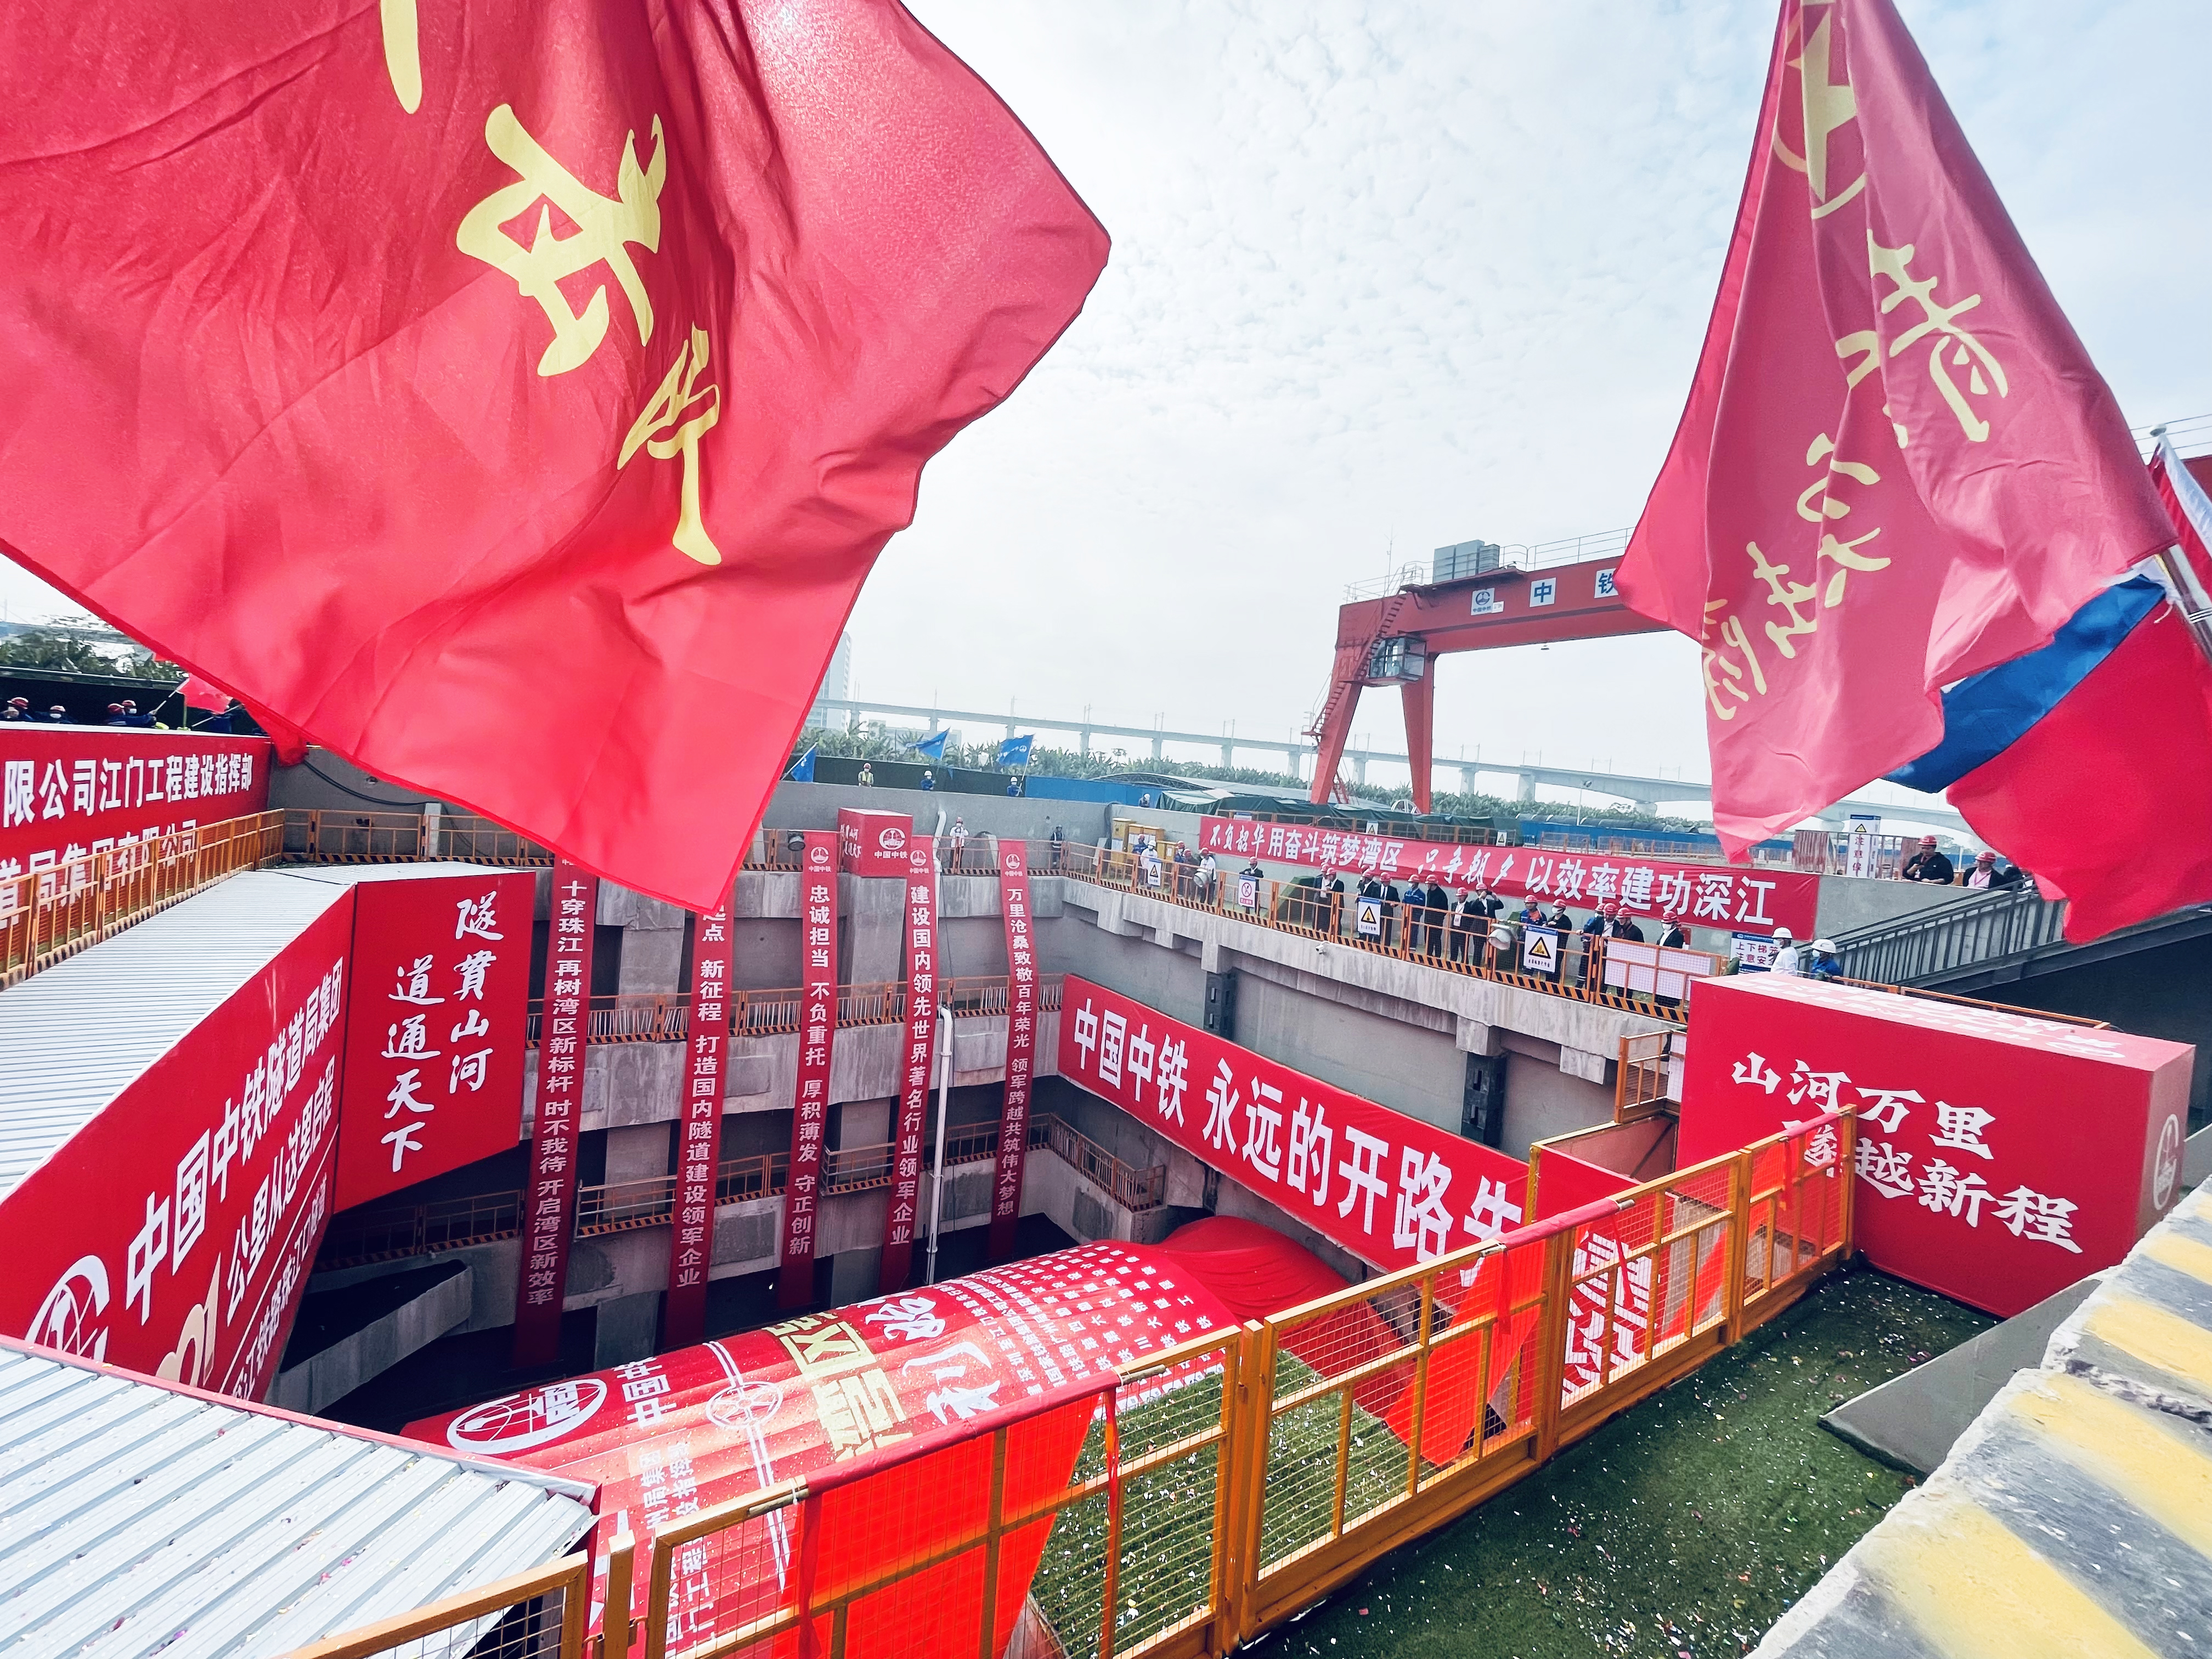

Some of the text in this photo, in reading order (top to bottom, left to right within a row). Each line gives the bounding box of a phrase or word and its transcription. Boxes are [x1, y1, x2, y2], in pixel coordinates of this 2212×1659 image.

[3, 753, 253, 827] 限公司江门工程建设指挥部
[874, 851, 908, 859] 中国中铁
[381, 954, 445, 1172] 道通天下
[698, 960, 725, 1022] 新征程
[789, 885, 830, 1255] 忠诚担当 不负重托 厚积薄发 守正创新
[890, 885, 932, 1245] 建设国内领先世界著名行业领军企业
[996, 888, 1033, 1216] 万里沧桑致敬百年荣光 领军跨越共筑伟大梦想
[1074, 998, 1188, 1127] 中国中铁
[126, 956, 343, 1326] 中国中铁隧道局集团
[677, 1035, 720, 1288] 打造国内隧道建设领军企业
[1731, 1052, 1996, 1159] 山河万里
